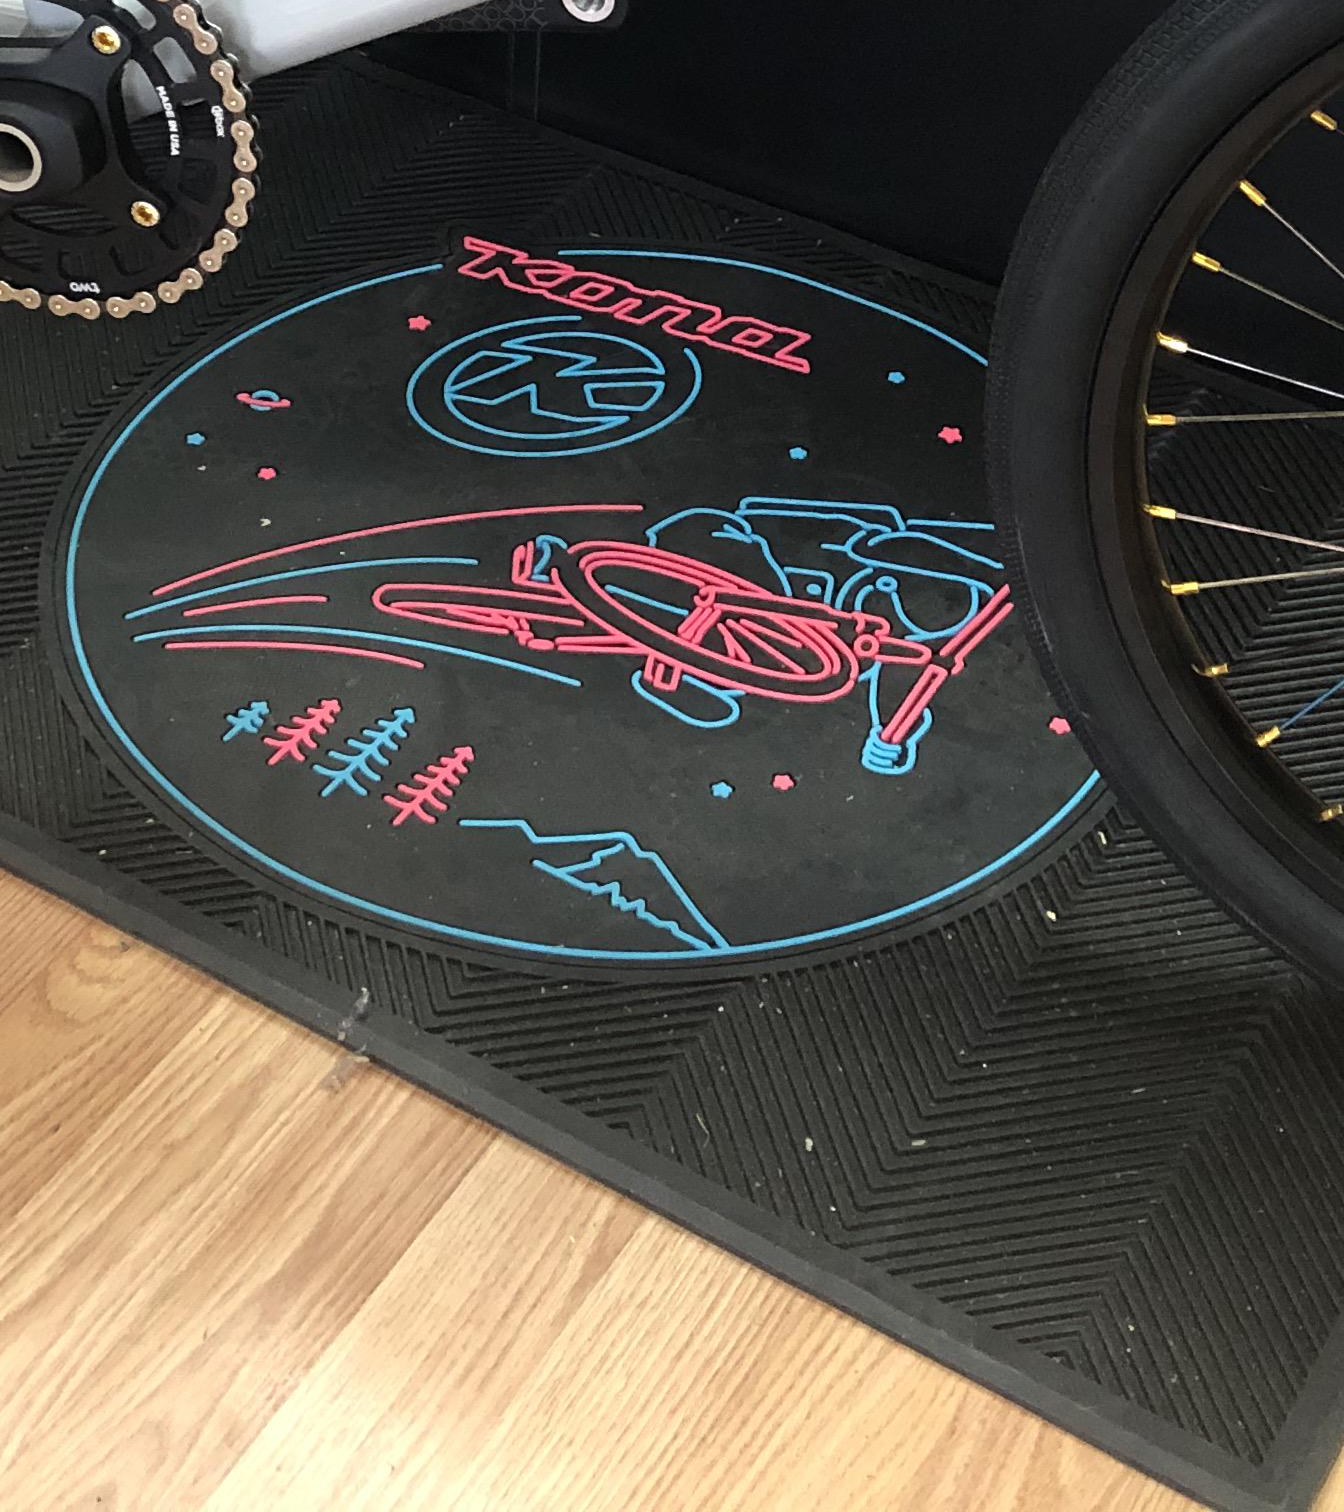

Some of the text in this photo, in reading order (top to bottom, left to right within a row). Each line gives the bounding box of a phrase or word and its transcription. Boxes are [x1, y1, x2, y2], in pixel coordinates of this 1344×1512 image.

[156, 86, 180, 156] MADE IN USA
